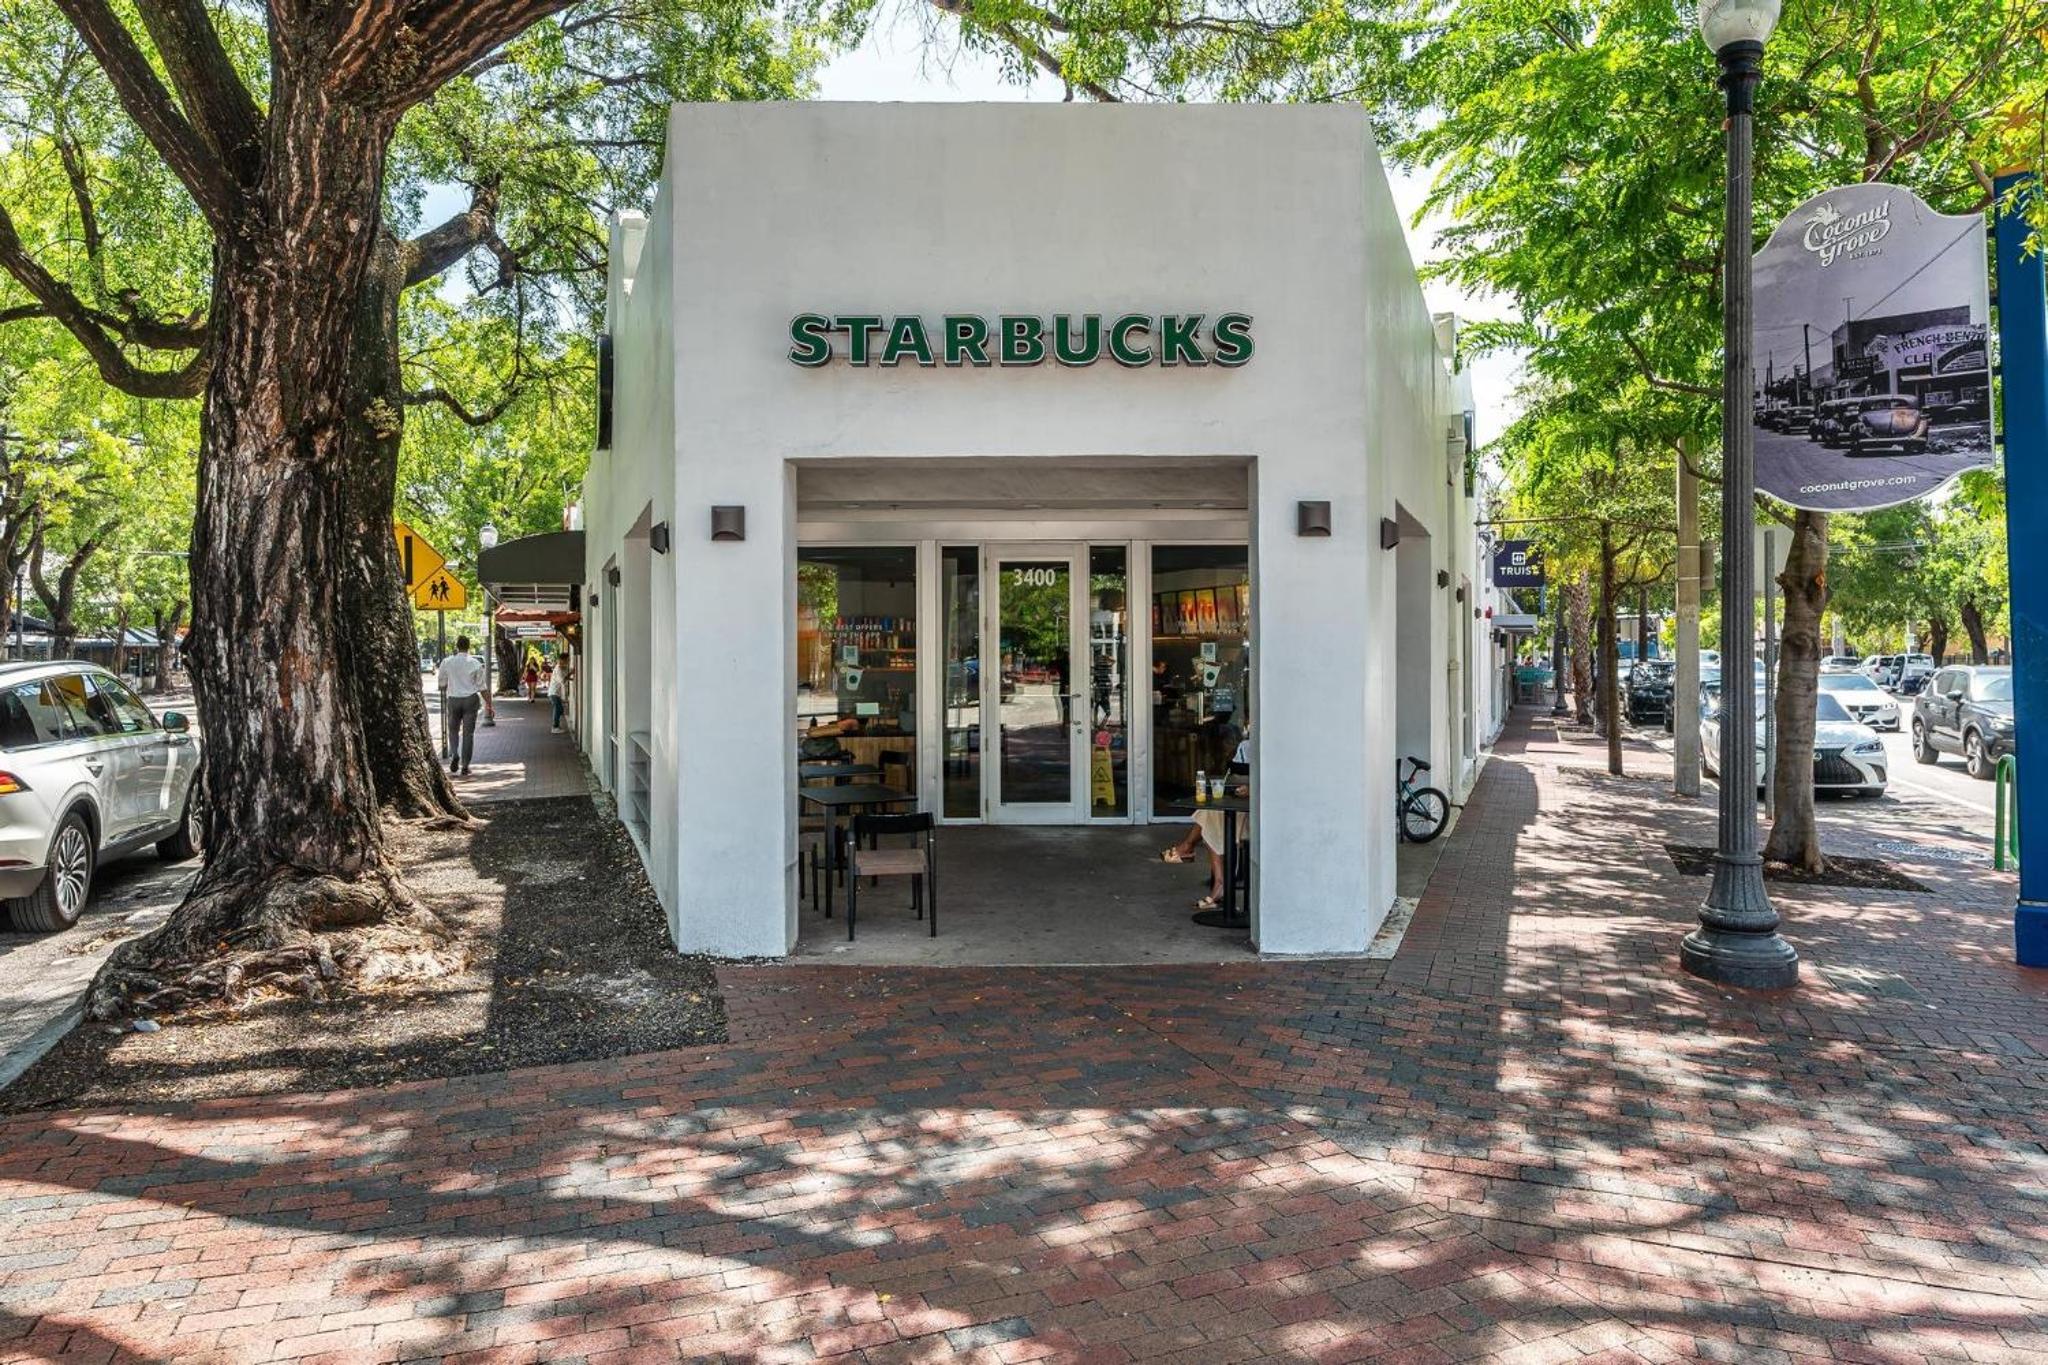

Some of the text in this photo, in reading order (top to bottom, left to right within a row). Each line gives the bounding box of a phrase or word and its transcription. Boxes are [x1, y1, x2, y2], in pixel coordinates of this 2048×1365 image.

[1804, 200, 1889, 251] Coconut
[787, 312, 1256, 368] STARBUCKS
[1800, 475, 1916, 494] coconutgrove.com
[1013, 568, 1056, 587] 3400
